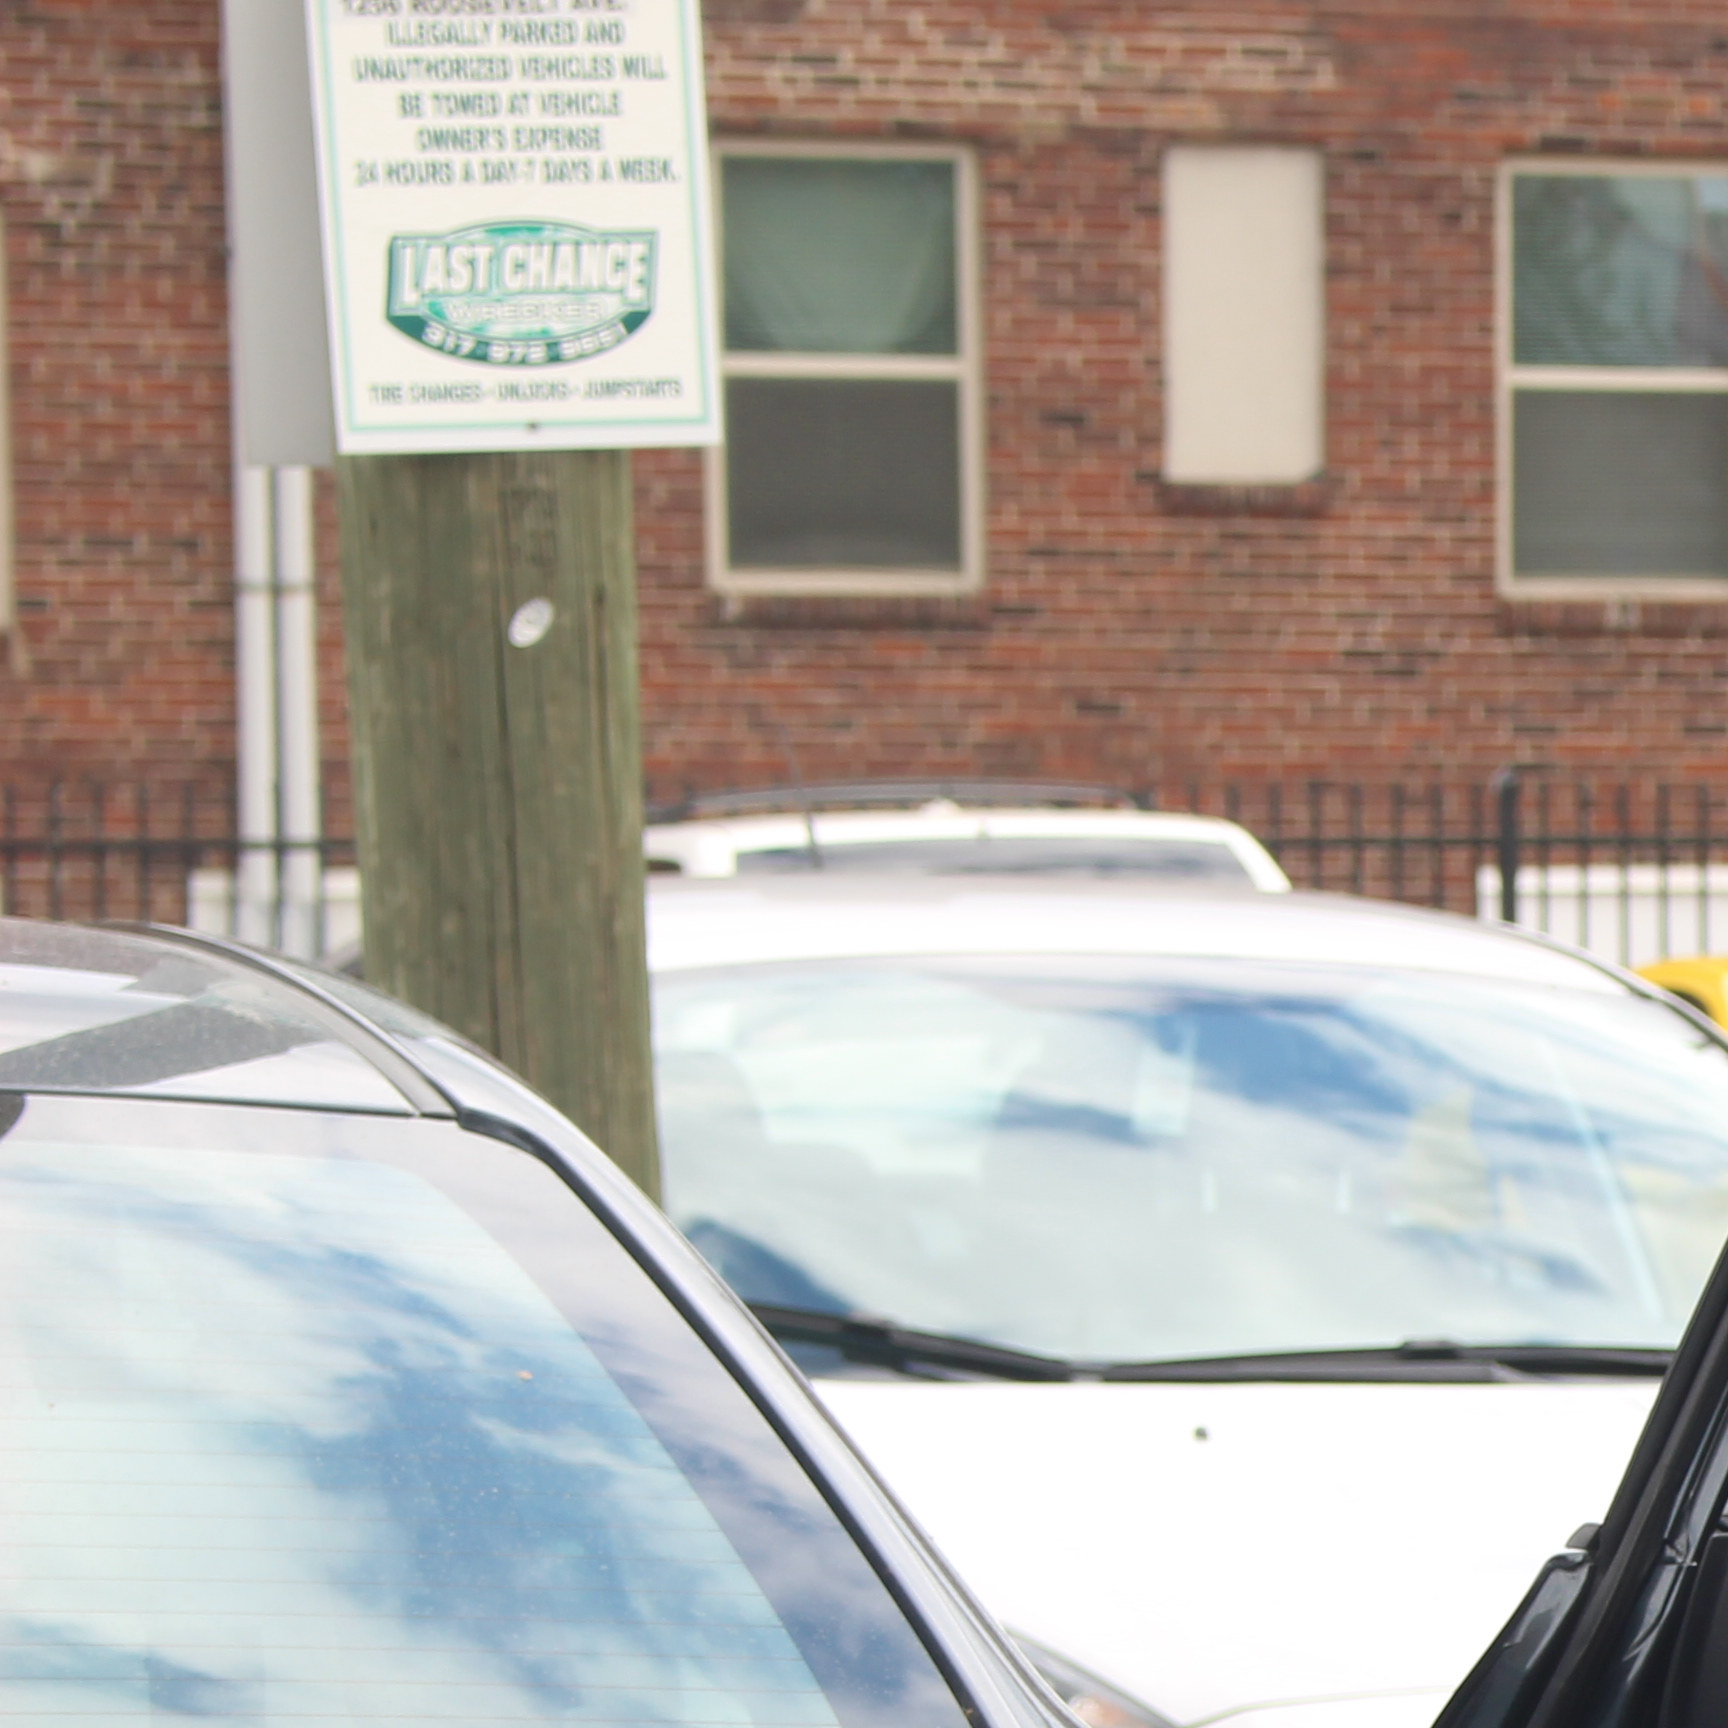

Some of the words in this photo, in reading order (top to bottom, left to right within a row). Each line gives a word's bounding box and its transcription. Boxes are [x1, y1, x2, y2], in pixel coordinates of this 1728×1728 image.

[386, 20, 491, 46] ILLEGALLY
[500, 19, 577, 45] PARKED
[585, 20, 625, 45] AND
[353, 55, 512, 81] UNAUTHORIZED
[520, 54, 615, 80] VEHICLES
[622, 54, 667, 79] WILL
[400, 92, 423, 117] BE
[431, 92, 501, 116] TOWED
[506, 92, 531, 115] AT
[539, 91, 622, 115] VEHICLE
[416, 127, 506, 151] OWNER'S
[514, 126, 604, 150] EXPENSE
[355, 161, 379, 186] 24
[386, 160, 454, 185] HOURS
[460, 160, 477, 184] A
[543, 159, 591, 183] DAYS
[599, 159, 615, 182] A
[402, 242, 495, 304] LAST
[504, 241, 650, 301] CHANCE
[447, 302, 603, 322] WRECKER
[422, 322, 477, 358] 317
[370, 384, 403, 405] TIRE
[410, 382, 481, 403] CHANGES
[498, 381, 568, 402] UNLOCKS
[585, 377, 683, 400] JUMPSTARTS
